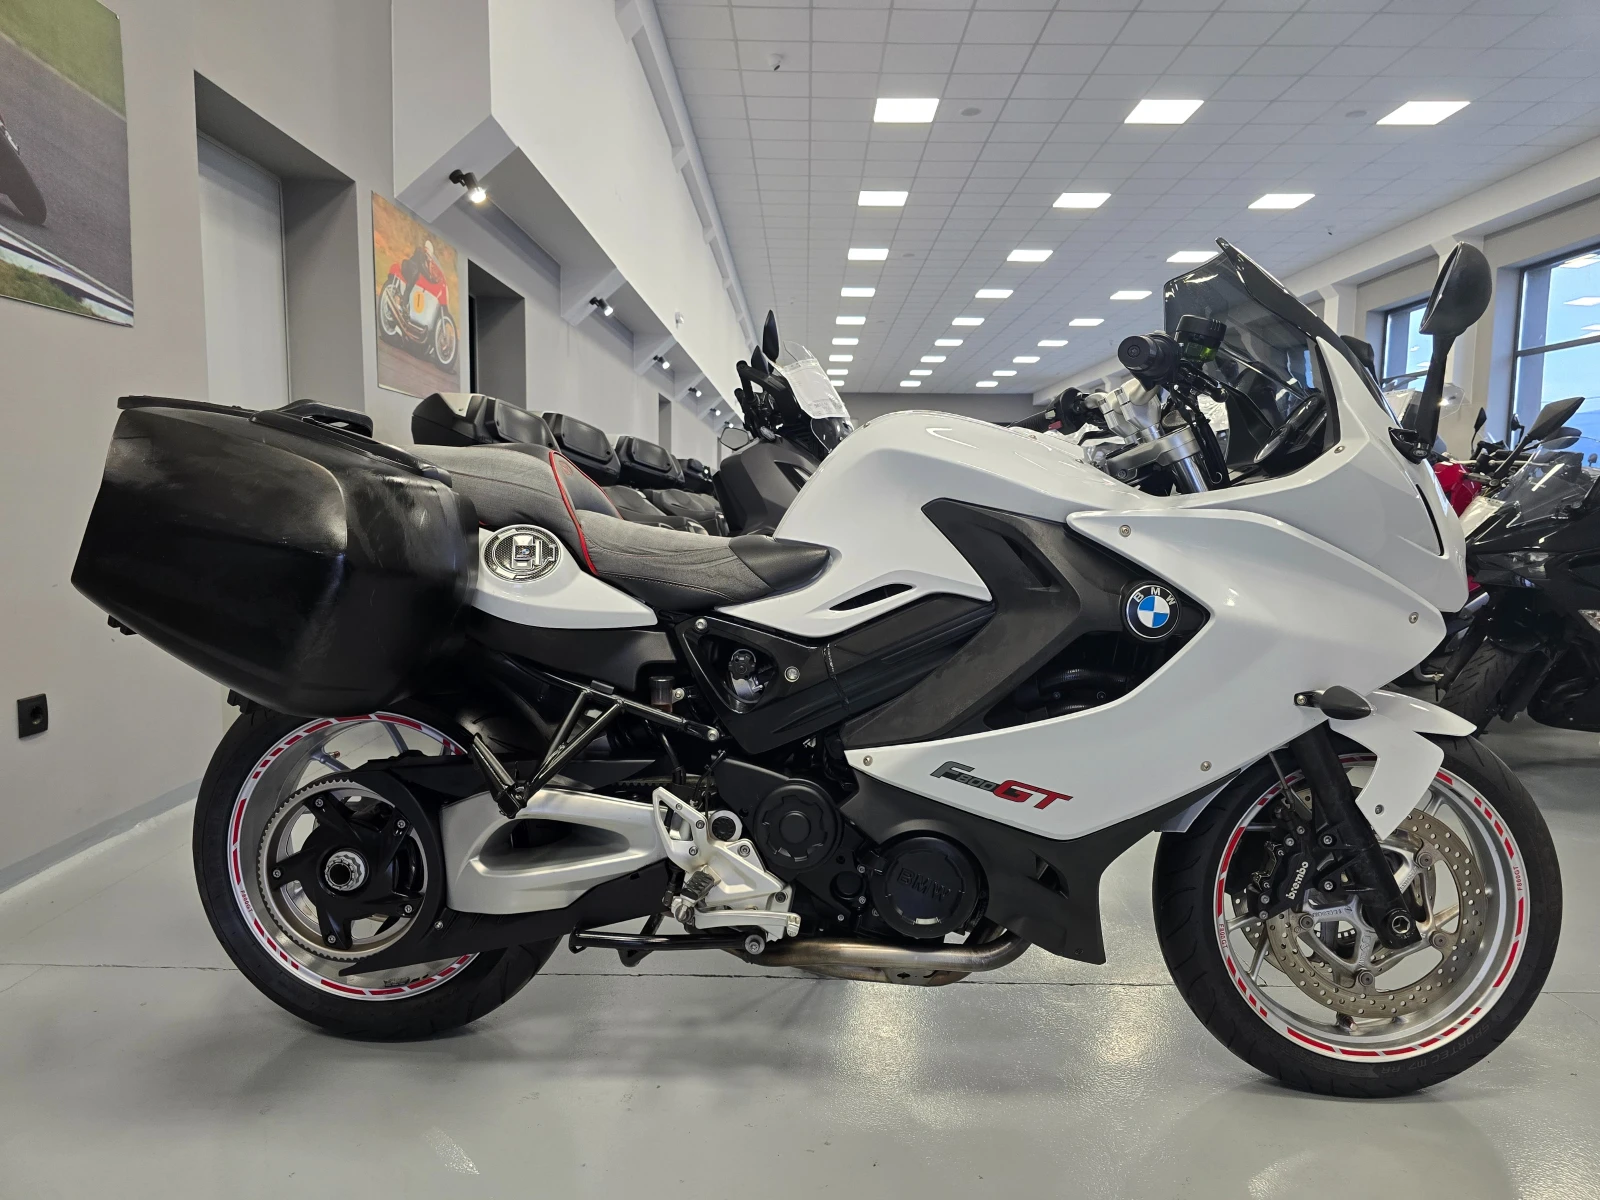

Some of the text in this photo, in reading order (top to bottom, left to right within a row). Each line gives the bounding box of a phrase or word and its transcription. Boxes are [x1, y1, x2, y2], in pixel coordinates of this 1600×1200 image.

[1133, 587, 1176, 606] BMW
[896, 867, 952, 902] BMW
[1285, 861, 1309, 900] brembo
[1512, 866, 1523, 891] F800GT
[1218, 923, 1229, 949] F800GT
[1431, 1021, 1491, 1064] SPORTEC
